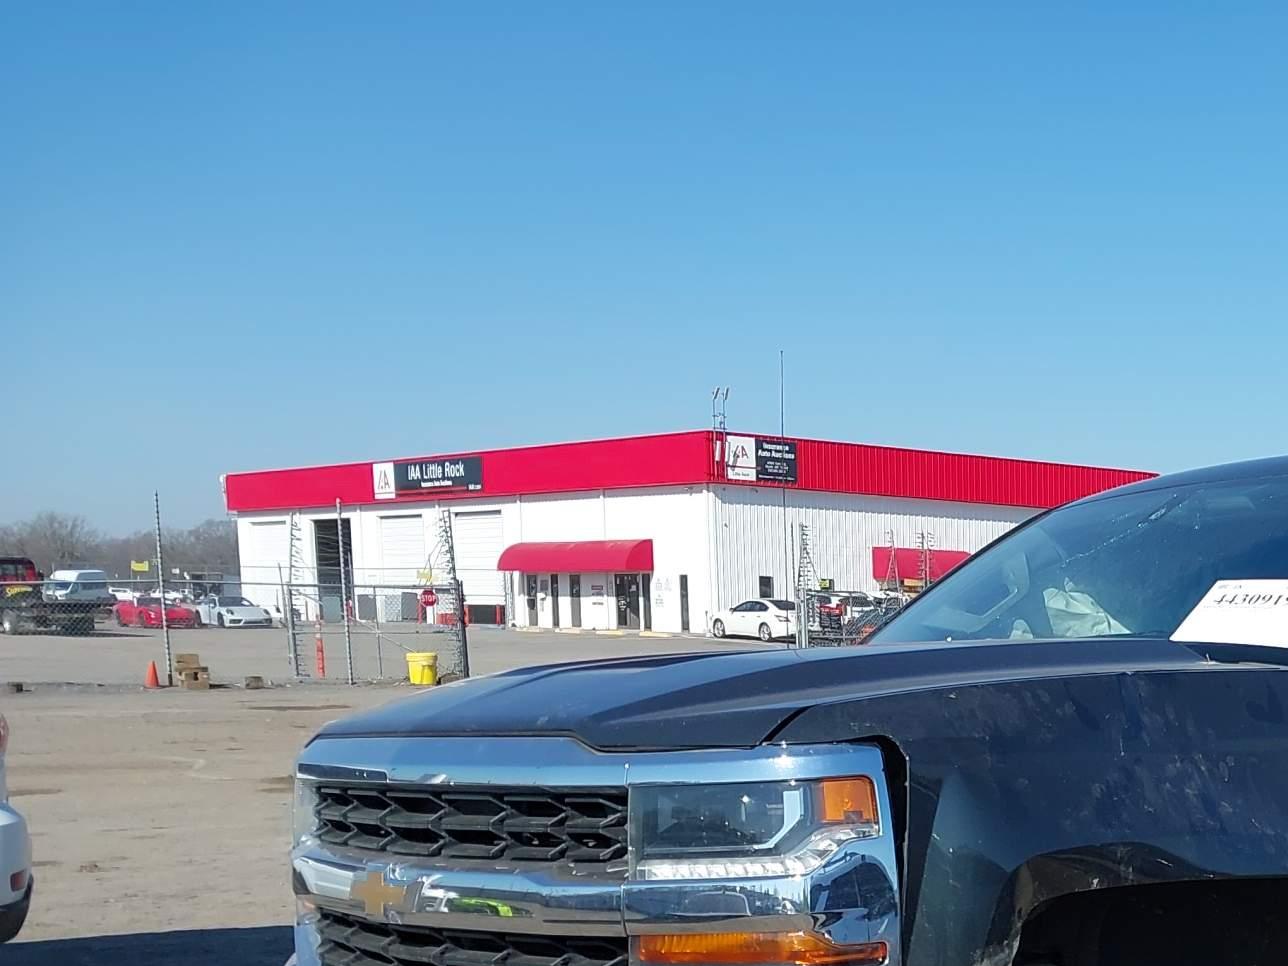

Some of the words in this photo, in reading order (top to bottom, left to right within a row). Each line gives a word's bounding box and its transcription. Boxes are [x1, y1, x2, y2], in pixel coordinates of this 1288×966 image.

[407, 464, 421, 481] IAA
[422, 462, 443, 480] Little
[444, 460, 465, 478] Rock
[420, 594, 437, 603] STOP
